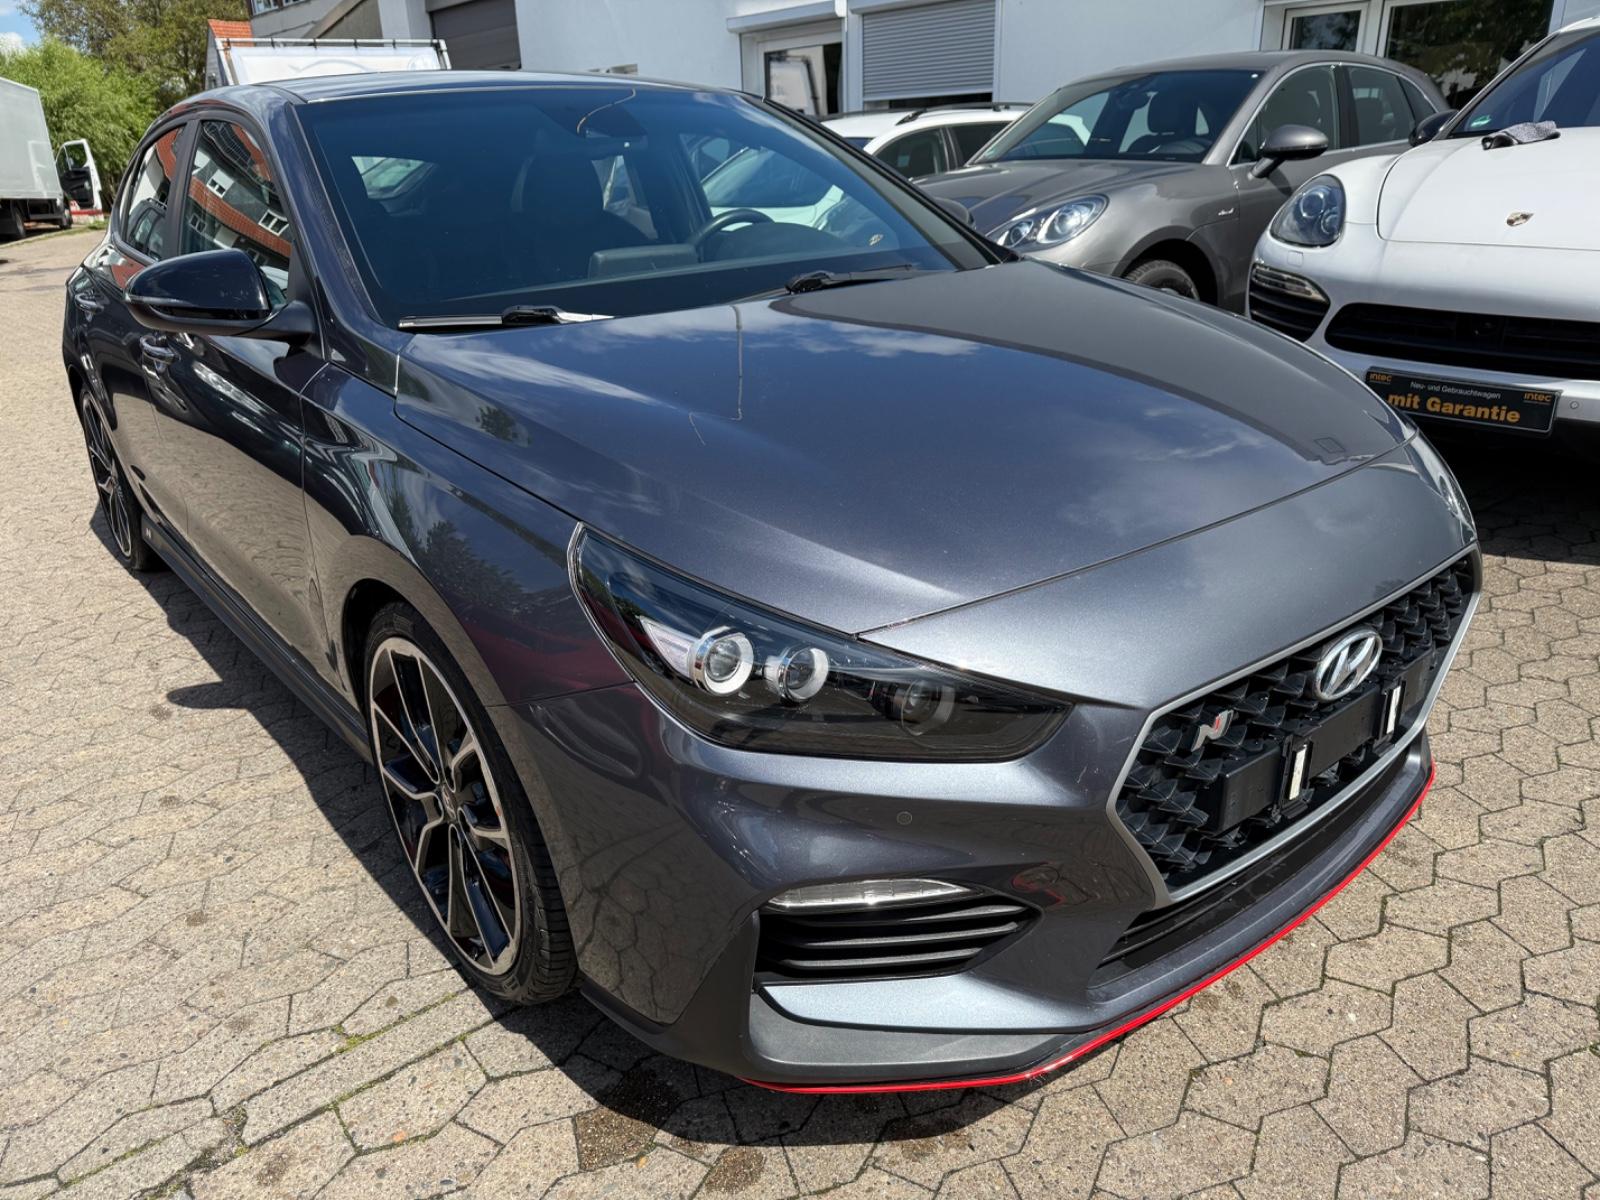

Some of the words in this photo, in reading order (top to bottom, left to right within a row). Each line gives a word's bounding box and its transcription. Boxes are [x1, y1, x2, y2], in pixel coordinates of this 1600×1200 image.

[1369, 373, 1393, 382] intec
[1427, 384, 1441, 392] und
[1441, 385, 1501, 399] Gebrauchtwagen
[1523, 392, 1552, 402] intec
[1387, 393, 1420, 409] mit
[1426, 396, 1520, 423] Garantie
